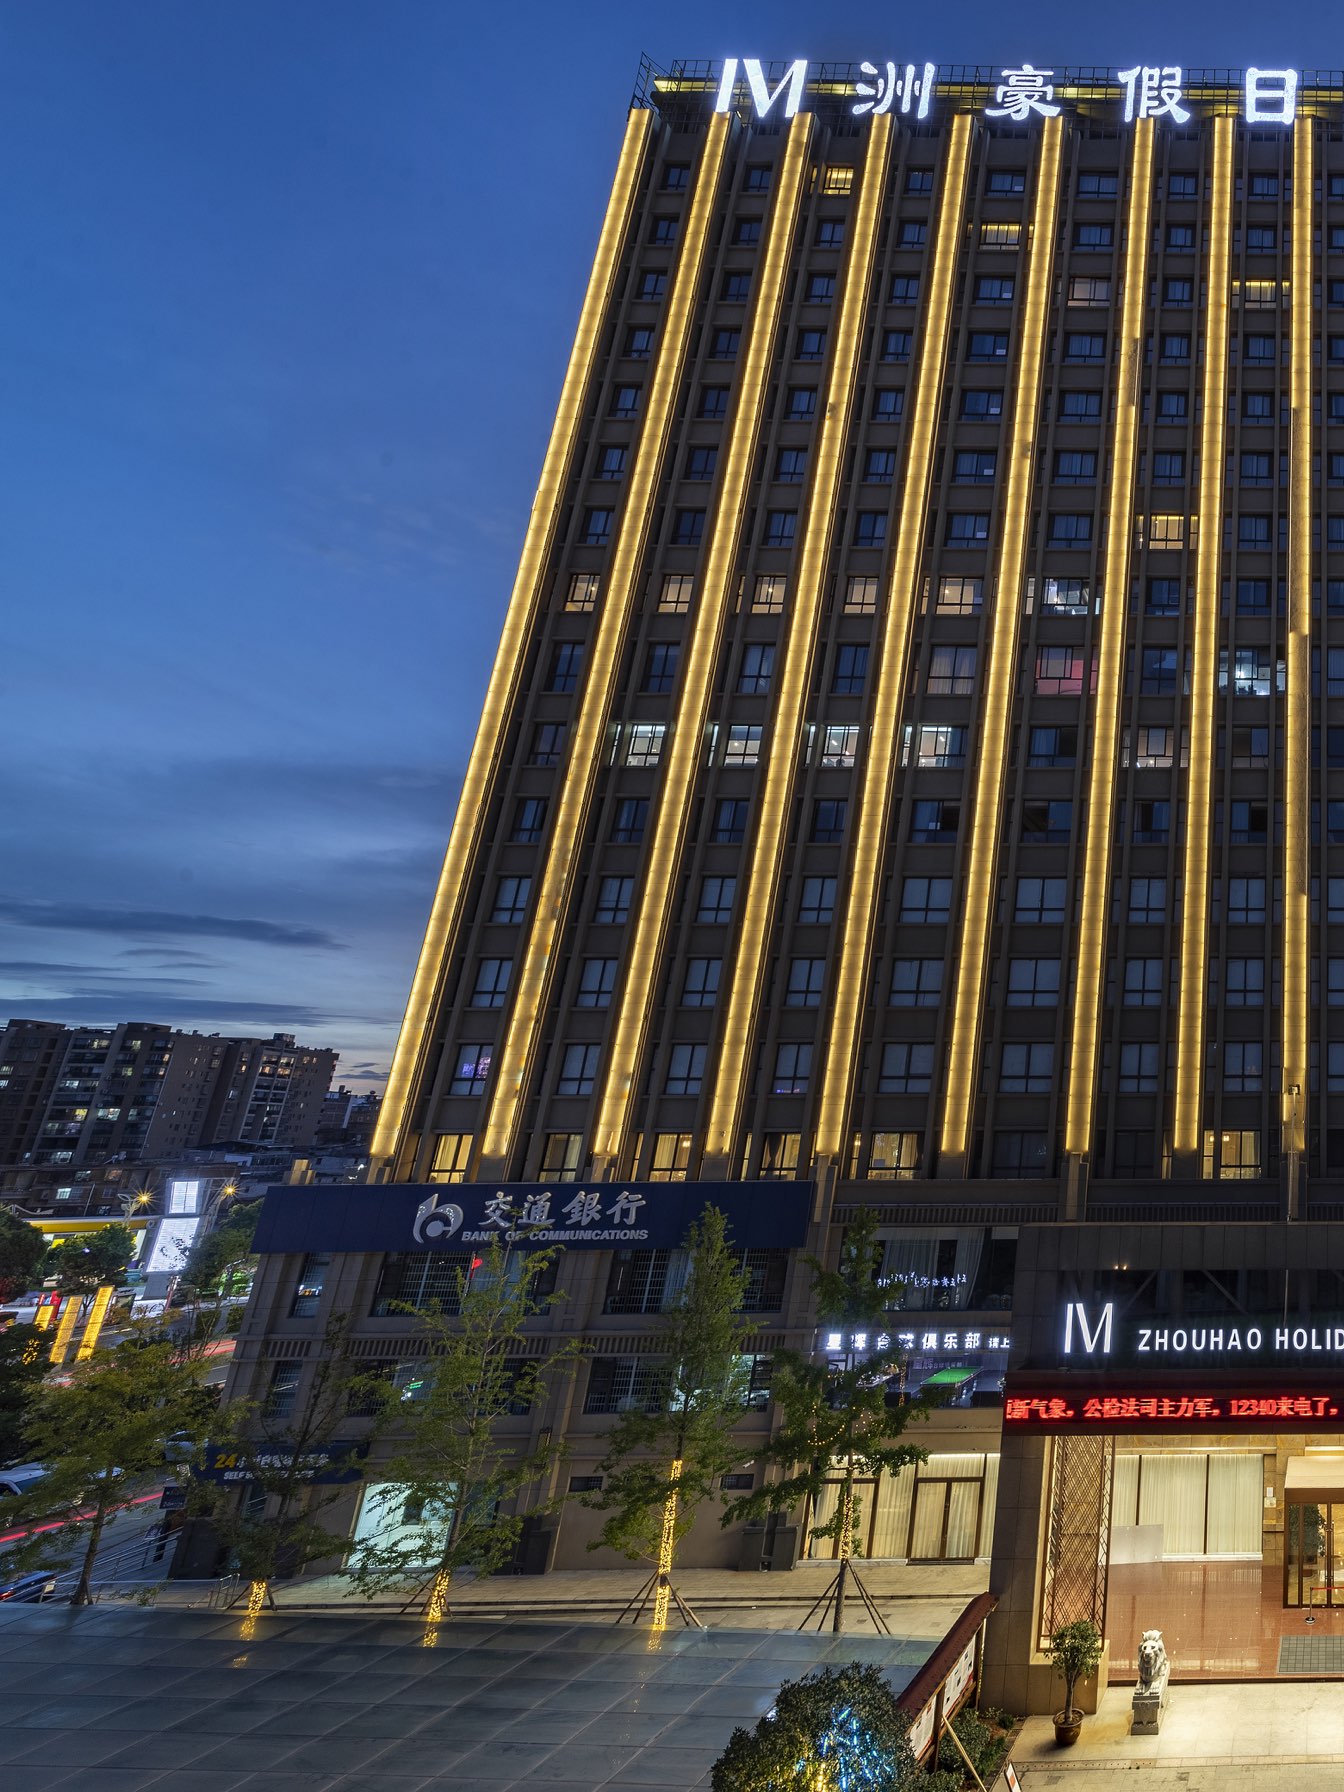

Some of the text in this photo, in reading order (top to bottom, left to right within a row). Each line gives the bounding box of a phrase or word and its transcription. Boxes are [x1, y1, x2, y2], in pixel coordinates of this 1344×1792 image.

[461, 1230, 500, 1242] BANK
[529, 1229, 649, 1241] COMMUNICATIONS
[1138, 1328, 1263, 1351] ZHOUHAO
